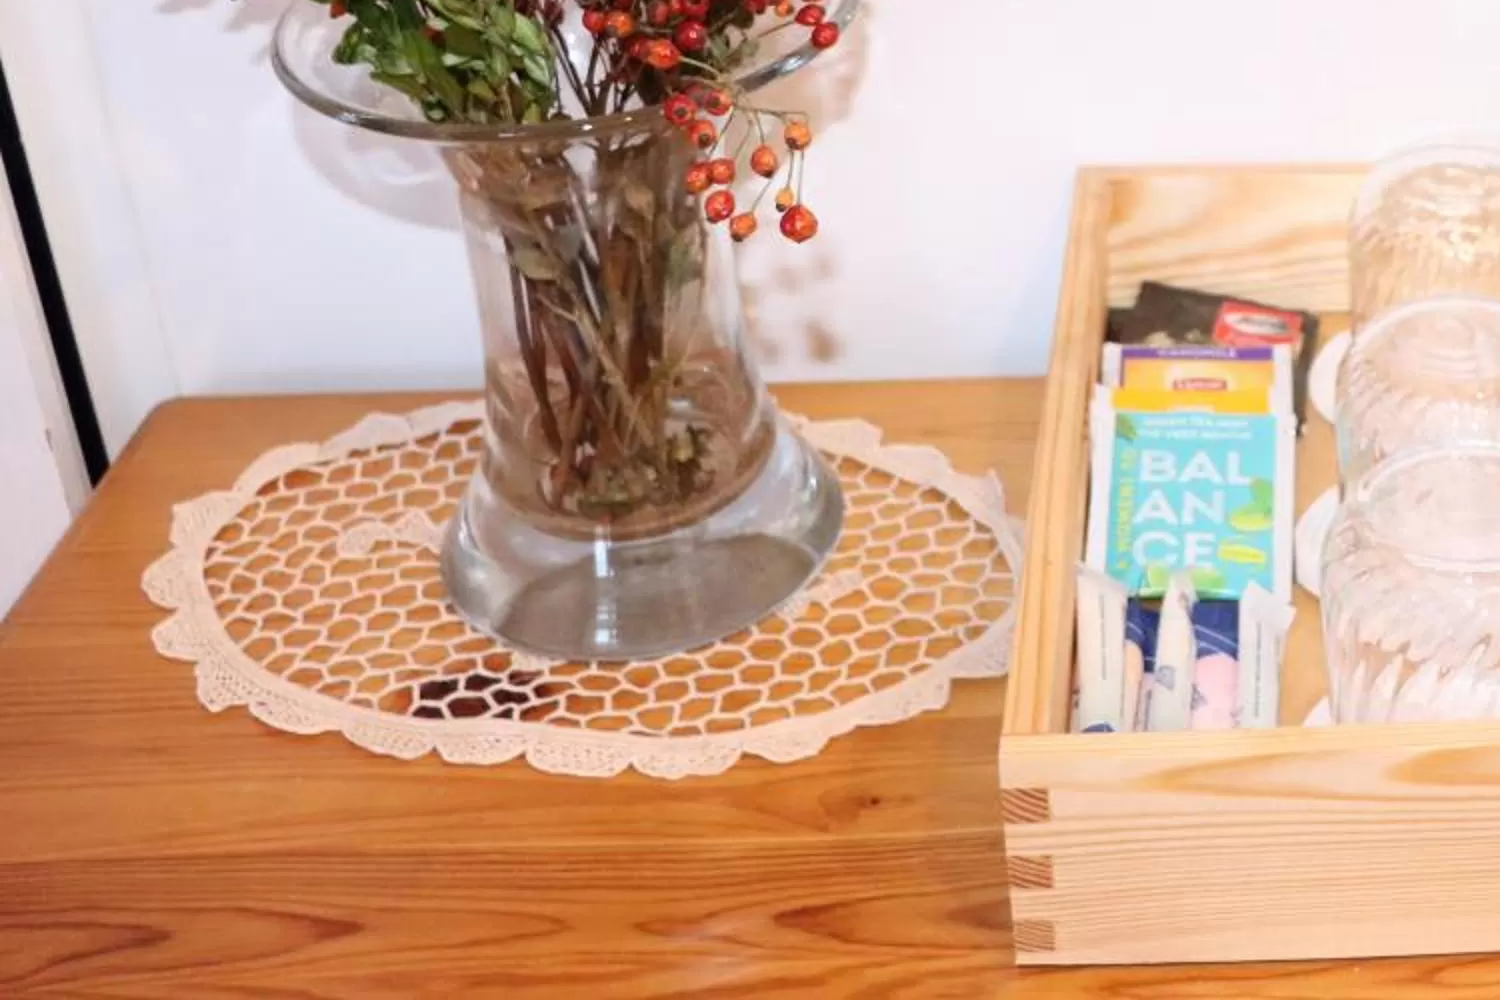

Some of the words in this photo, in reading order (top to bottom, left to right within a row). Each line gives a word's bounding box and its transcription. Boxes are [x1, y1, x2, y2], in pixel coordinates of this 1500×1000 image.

[1139, 449, 1253, 486] BAL
[1132, 488, 1225, 526] AN
[1131, 530, 1217, 570] CE
